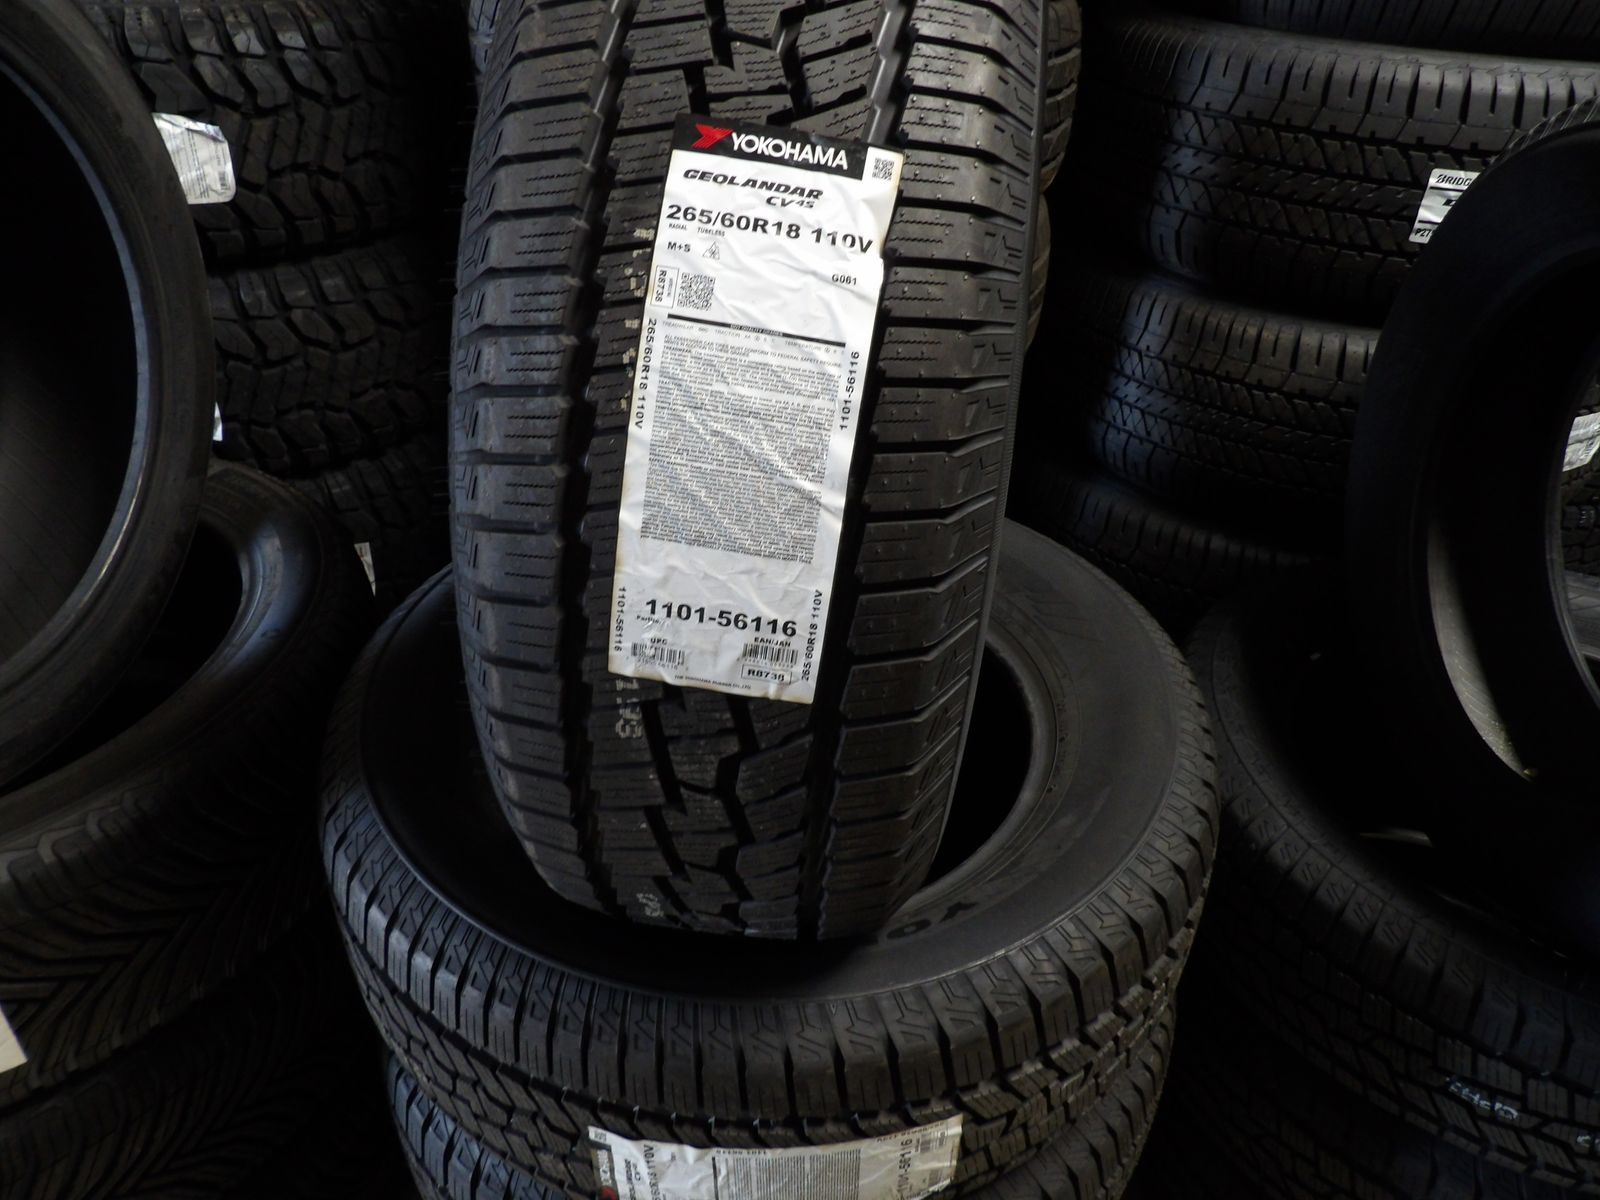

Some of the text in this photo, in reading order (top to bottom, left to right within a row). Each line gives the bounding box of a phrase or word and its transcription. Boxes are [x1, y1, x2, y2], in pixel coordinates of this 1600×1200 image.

[731, 131, 848, 171] YOKOHAMA
[683, 169, 823, 200] GEOLANDAR
[766, 196, 815, 210] CV4S
[666, 204, 873, 255] 265/60R18 110V
[668, 223, 687, 232] RADIAL
[697, 226, 726, 238] TUBELESS
[1414, 228, 1433, 238] P27
[667, 241, 691, 253] M+S
[639, 318, 656, 390] 265/60R18
[840, 351, 859, 430] 1101-56116
[634, 396, 647, 429] 110V
[614, 586, 626, 651] 1101-56116
[646, 599, 797, 637] 1101-56116
[812, 589, 823, 619] 110V
